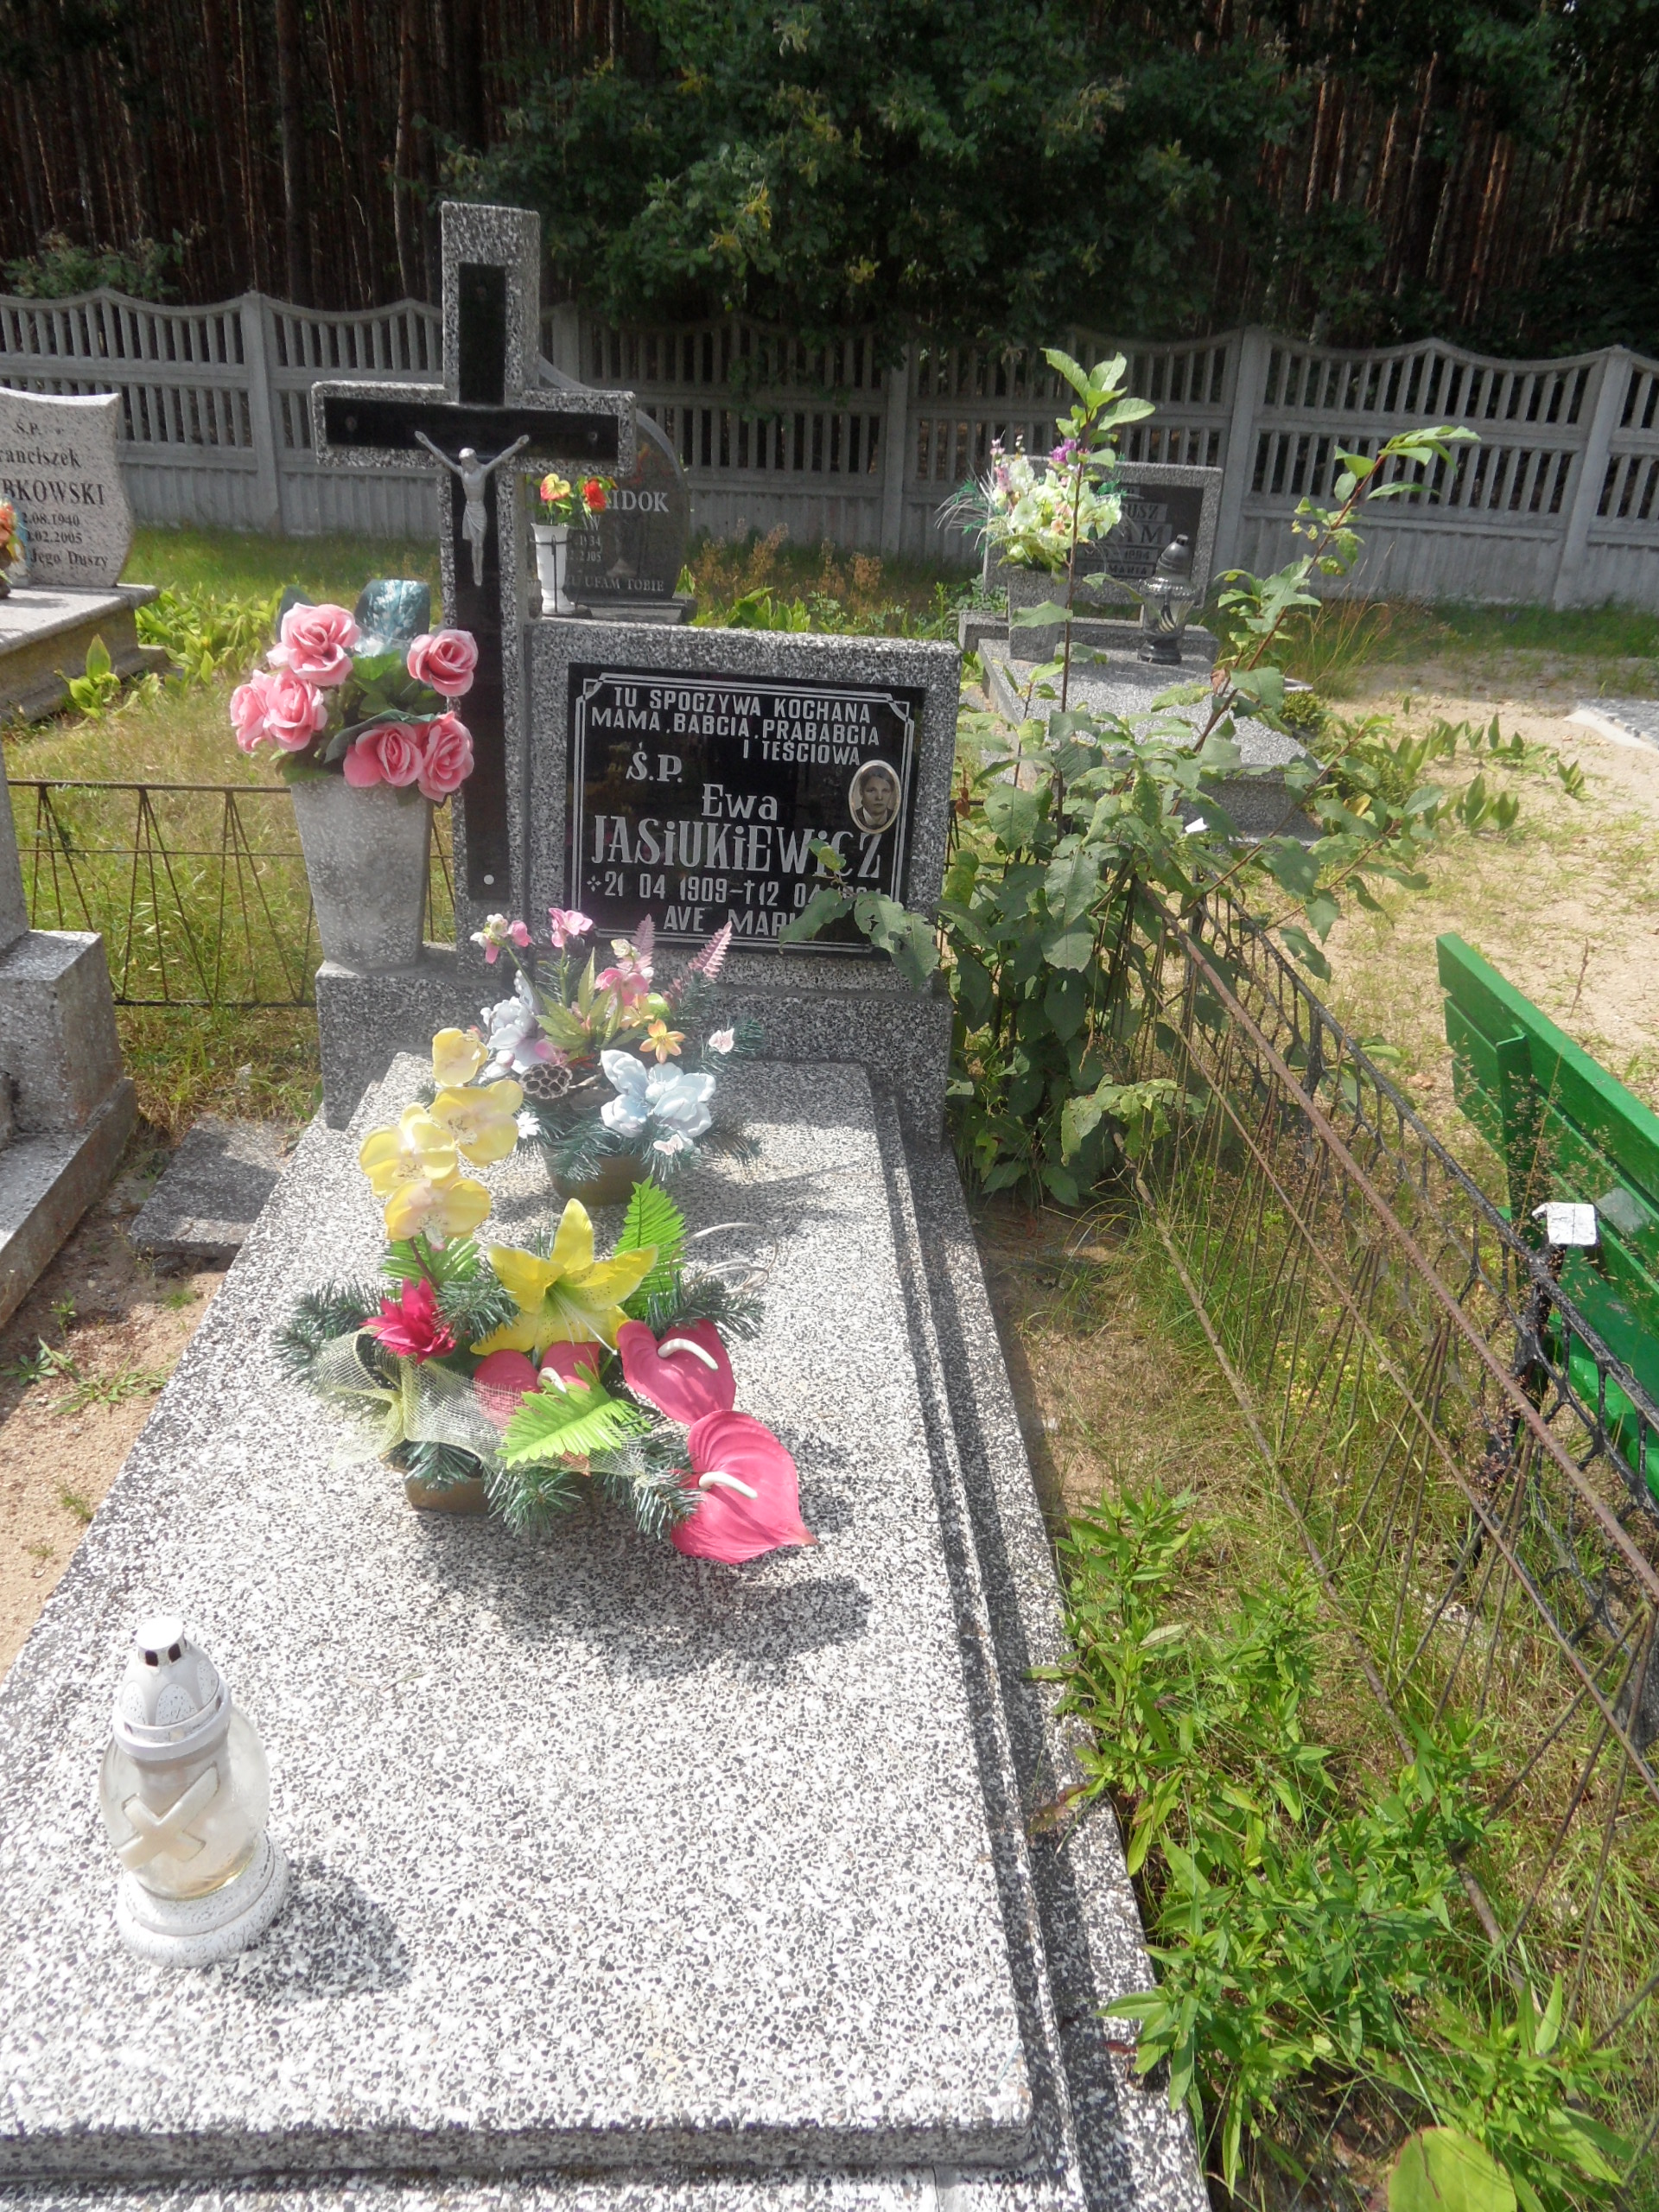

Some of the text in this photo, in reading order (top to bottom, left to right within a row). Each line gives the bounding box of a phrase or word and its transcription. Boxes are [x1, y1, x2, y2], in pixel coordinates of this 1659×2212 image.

[606, 489, 670, 512] IDOK
[627, 578, 664, 592] TOBIE
[614, 686, 870, 723] TU SPOCZYWA KOCHANA
[762, 719, 880, 746] PRABABCIA
[626, 741, 683, 783] Ś.P.
[743, 739, 861, 766] I TEŚCIOWA
[701, 783, 778, 821] Ewa
[639, 873, 665, 899] 04
[664, 905, 797, 937] AVE MAR
